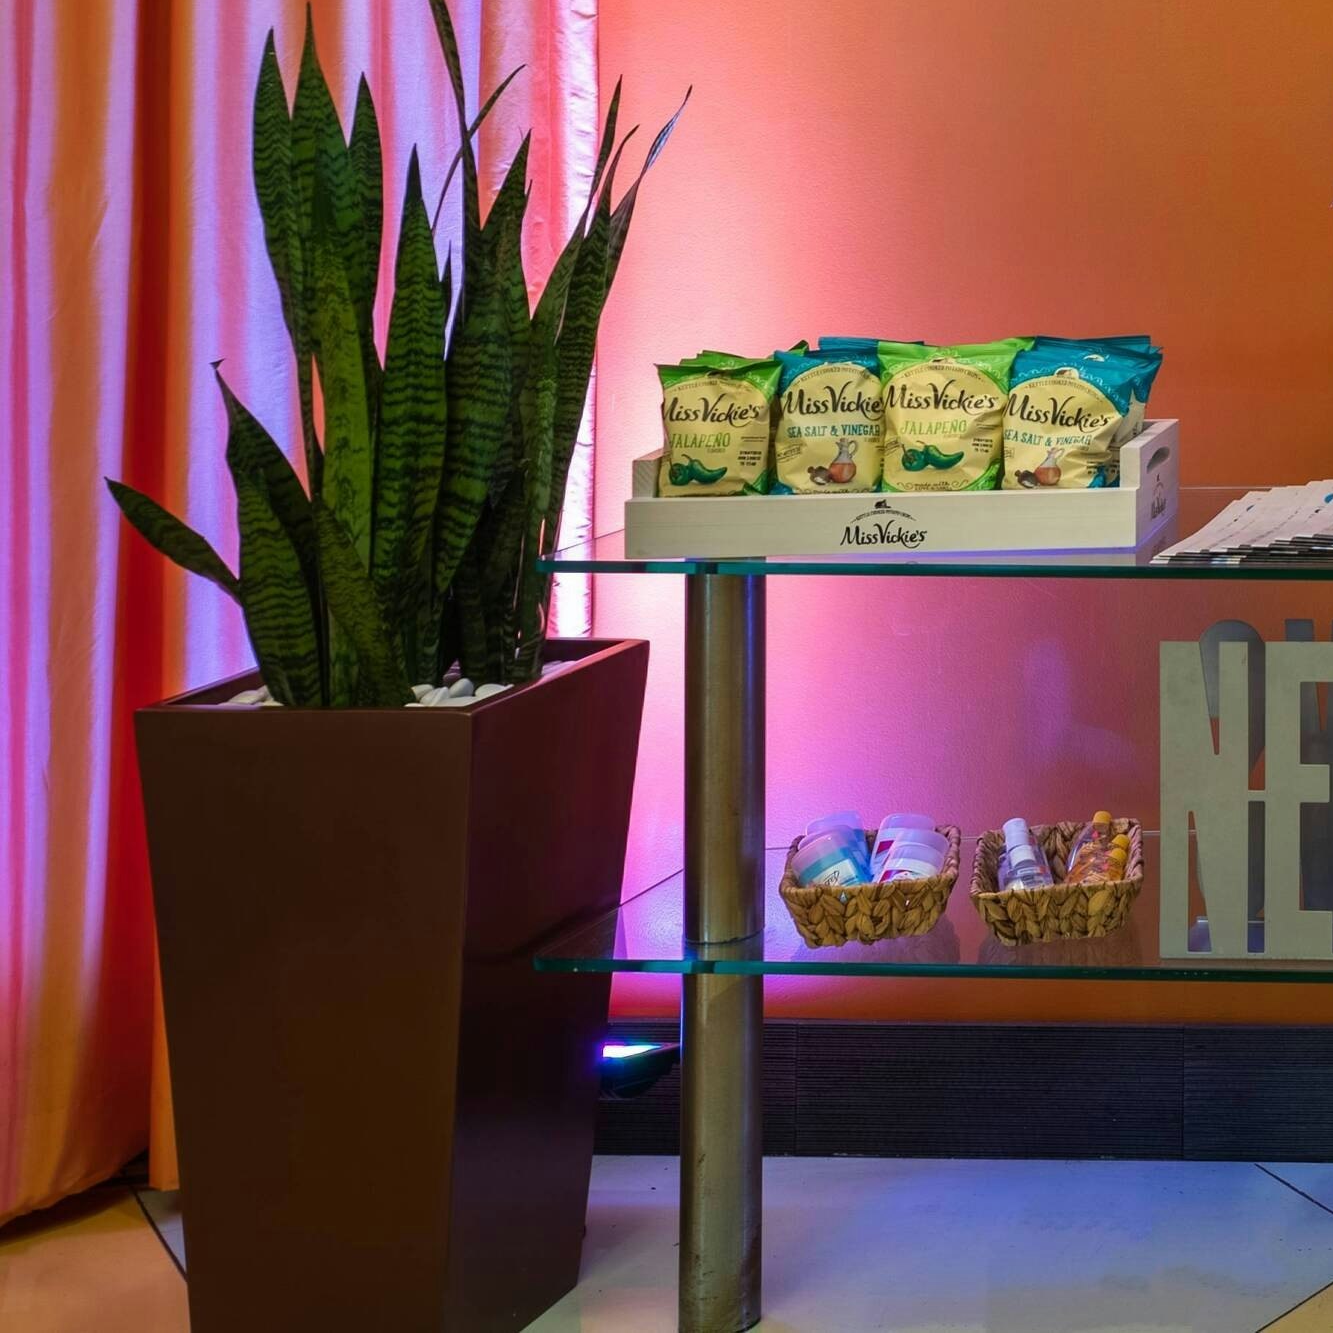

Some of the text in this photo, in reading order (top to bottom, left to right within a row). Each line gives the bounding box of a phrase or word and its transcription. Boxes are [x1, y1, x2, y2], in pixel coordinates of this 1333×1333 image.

[700, 393, 761, 428] Vickie's
[780, 389, 828, 416] Miss
[882, 379, 997, 415] Miss Vickie's
[1003, 393, 1112, 433] Miss Vickie's
[787, 424, 881, 439] SEA SALT & VINEGAR
[901, 419, 967, 436] JALAPEÑO
[1003, 429, 1019, 441] SEA
[1021, 430, 1044, 446] SALT
[1044, 435, 1053, 446] &
[840, 521, 927, 549] Miss Vickie's
